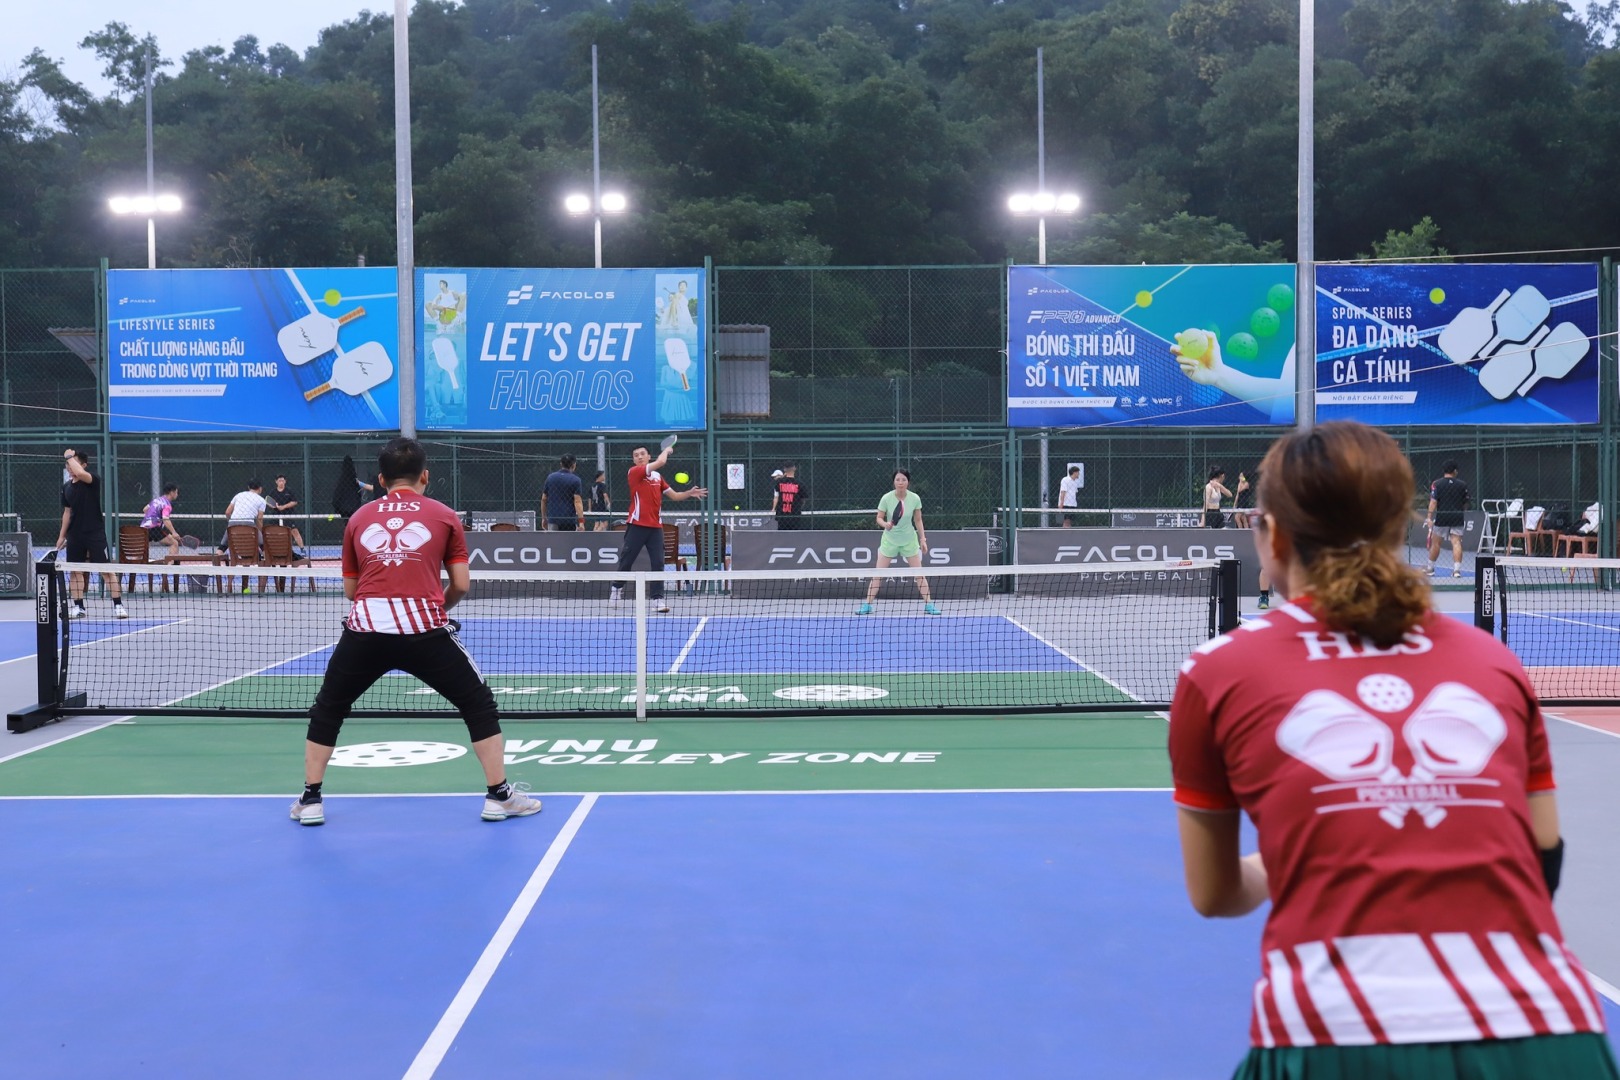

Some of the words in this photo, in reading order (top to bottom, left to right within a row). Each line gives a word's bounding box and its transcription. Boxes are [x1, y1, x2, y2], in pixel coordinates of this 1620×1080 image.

[540, 291, 615, 300] FACOLOS
[1084, 314, 1121, 324] ADVANCED
[1332, 306, 1368, 320] SPORT
[1372, 306, 1412, 319] SERIES
[120, 318, 174, 330] LIFESTYLE
[178, 318, 216, 330] SERIES
[480, 322, 573, 362] LET'S
[577, 322, 643, 362] GET
[1026, 330, 1070, 356] BÓNG
[1072, 334, 1099, 356] THI
[1102, 327, 1135, 356] ĐẤU
[1332, 326, 1358, 348] ĐA
[1366, 325, 1419, 353] DẠNG
[120, 336, 150, 357] CHẤT
[151, 340, 188, 360] LƯỢNG
[189, 338, 220, 357] HÀNG
[222, 336, 245, 356] ĐẦU
[120, 362, 156, 378] TRONG
[158, 360, 189, 378] DÒNG
[191, 362, 212, 381] VỢT
[214, 360, 239, 378] THỜI
[240, 362, 278, 378] TRANG
[1025, 359, 1050, 387] SỐ
[1052, 366, 1060, 387] 1
[1064, 361, 1100, 392] VIỆT
[1102, 365, 1140, 387] NAM
[1333, 356, 1358, 384] CÁ
[1364, 356, 1410, 383] TÍNH
[489, 369, 634, 411] FACOLOS
[377, 502, 420, 512] HES
[469, 547, 619, 564] ACOLOS
[768, 548, 950, 564] FACOS
[1054, 545, 1235, 562] FACOLOS
[1080, 572, 1207, 580] PICKLEBALL
[504, 739, 658, 752] VNU
[504, 752, 751, 764] VOLLEY
[758, 752, 942, 764] ZONE
[1356, 784, 1462, 802] PICKLEBALL
